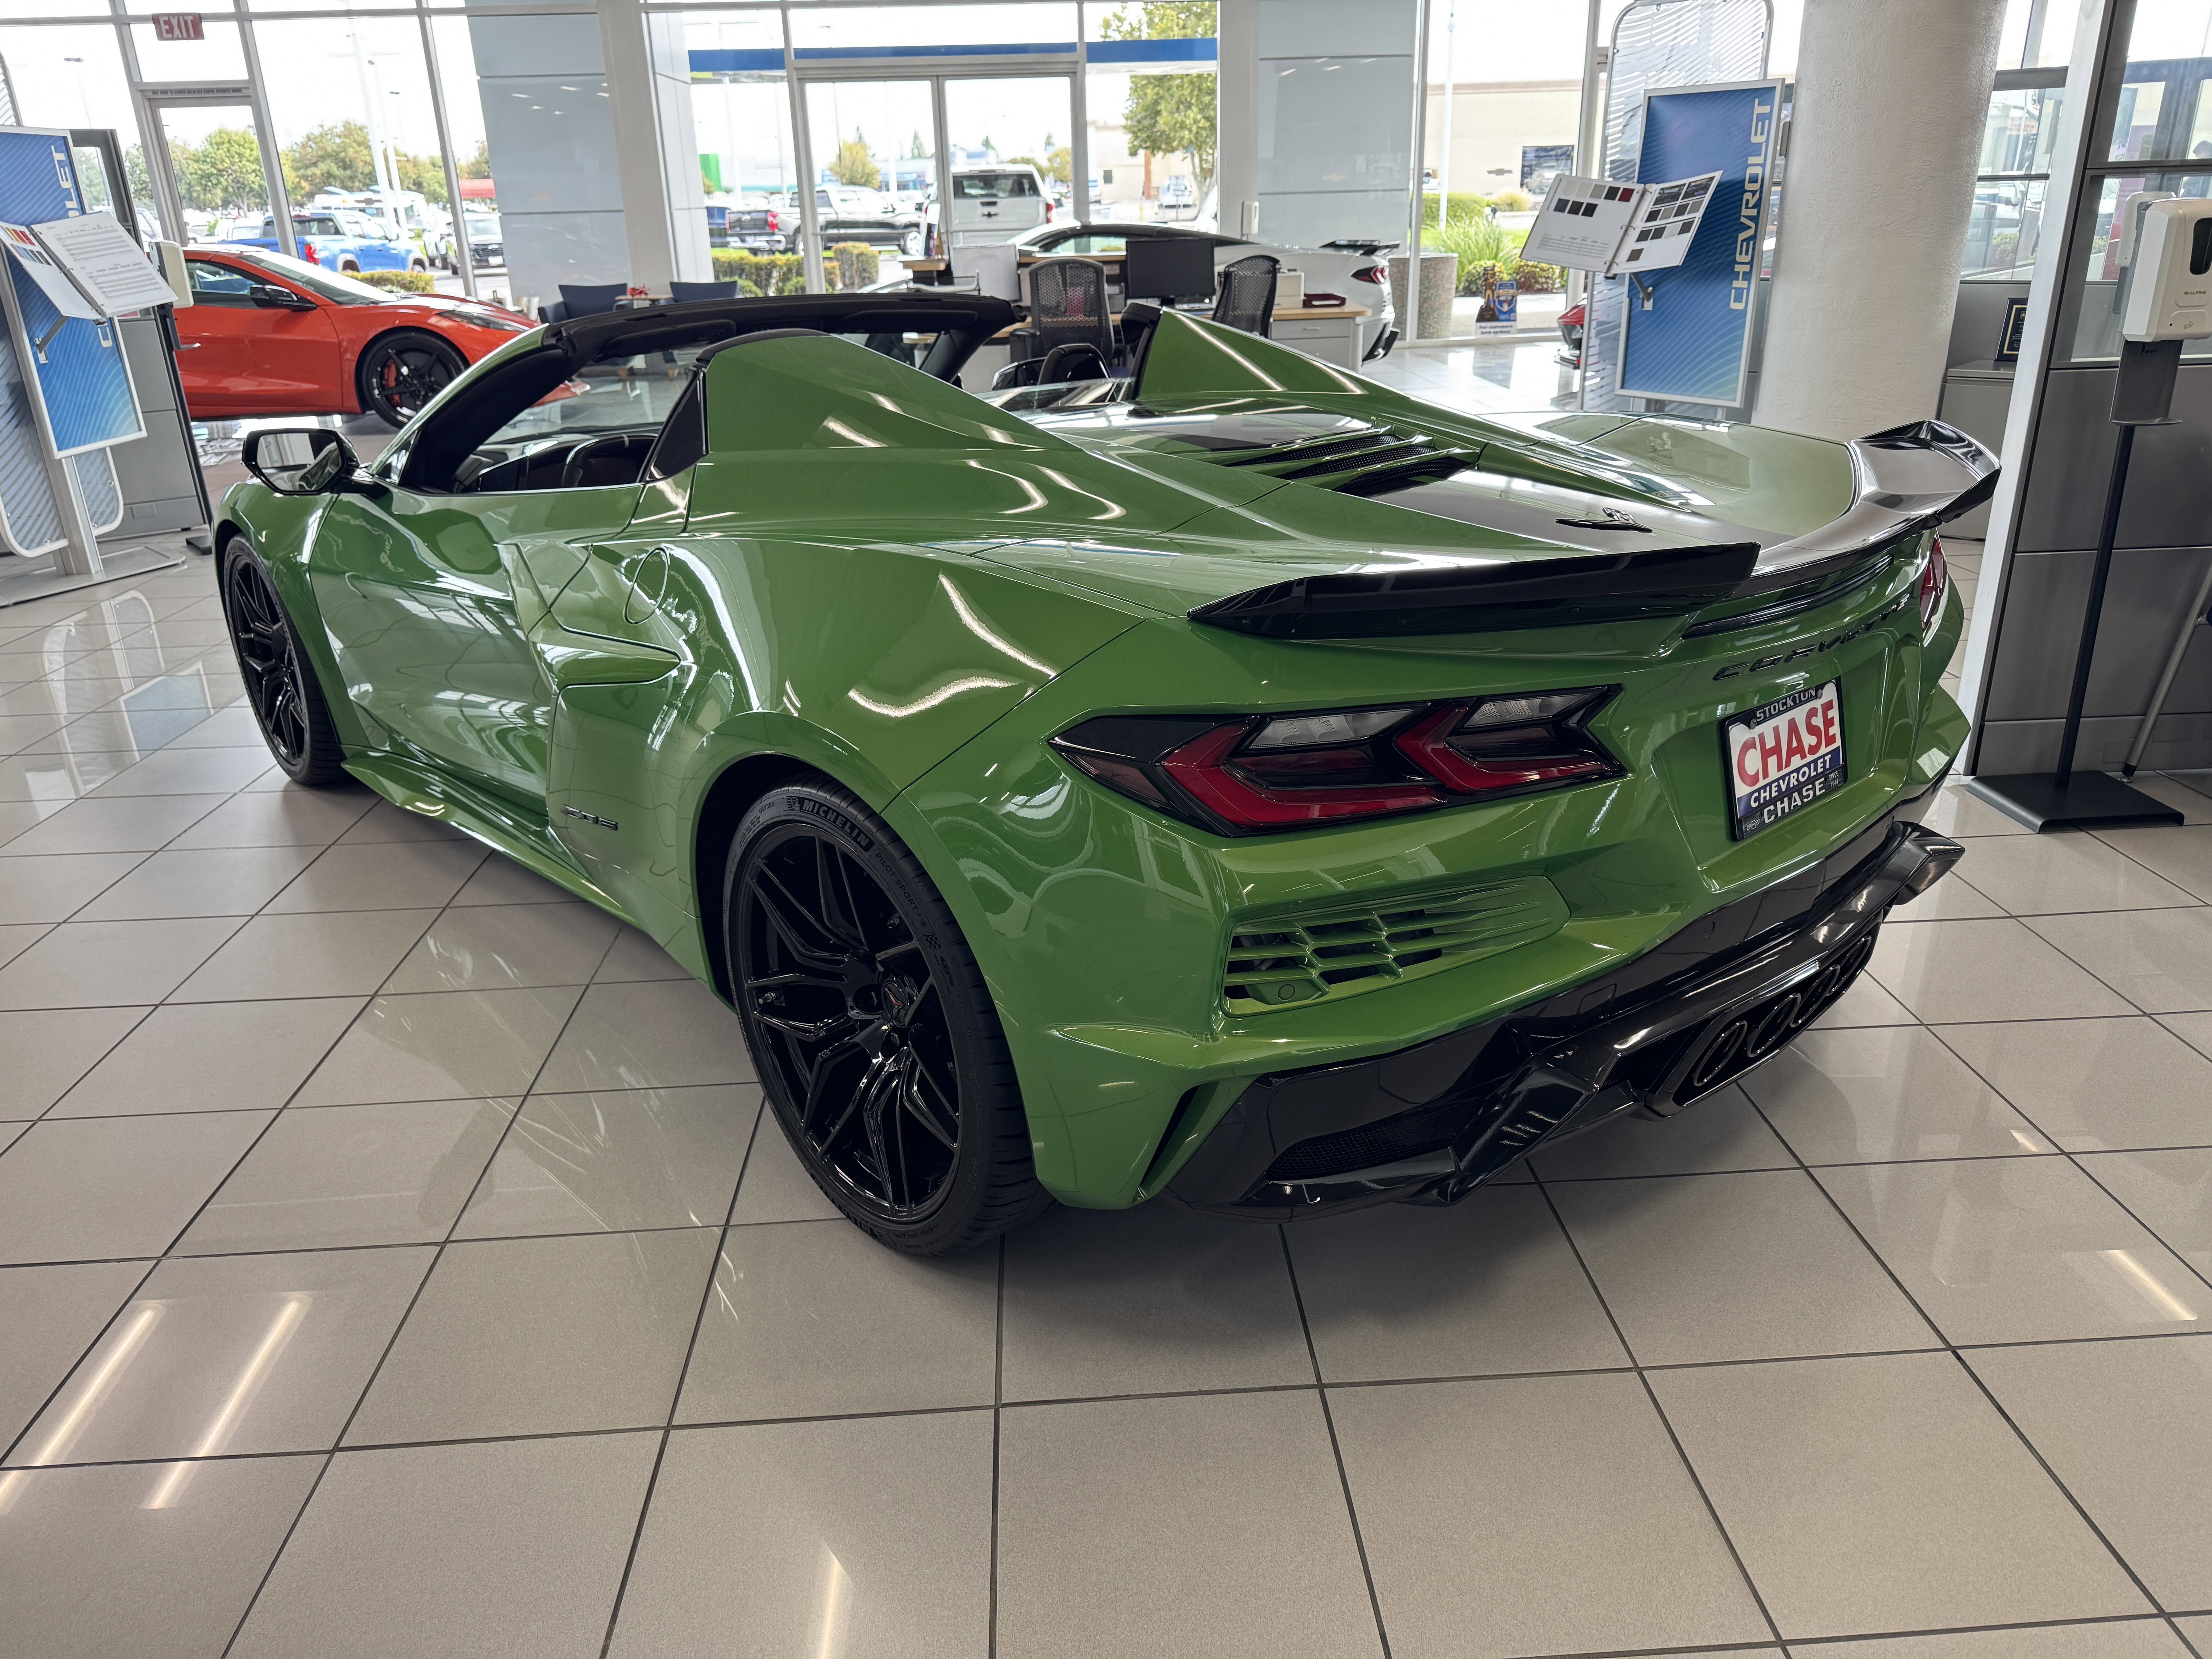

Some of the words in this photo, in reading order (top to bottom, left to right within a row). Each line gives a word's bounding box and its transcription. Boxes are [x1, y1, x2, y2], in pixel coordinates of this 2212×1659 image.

[159, 16, 194, 38] EXIT
[1729, 98, 1771, 310] CHEVROLET
[1712, 593, 1910, 681] CORVETTE
[1756, 687, 1816, 721] STOCKTON
[1737, 699, 1837, 787] CHASE
[1750, 754, 1831, 808] CHEVROLET
[1829, 771, 1839, 781] SINCE
[1830, 778, 1839, 788] 1944
[803, 800, 869, 847] MICHELIN
[1764, 778, 1826, 823] CHASE
[875, 853, 896, 877] PILOT
[896, 879, 919, 911] SPORT
